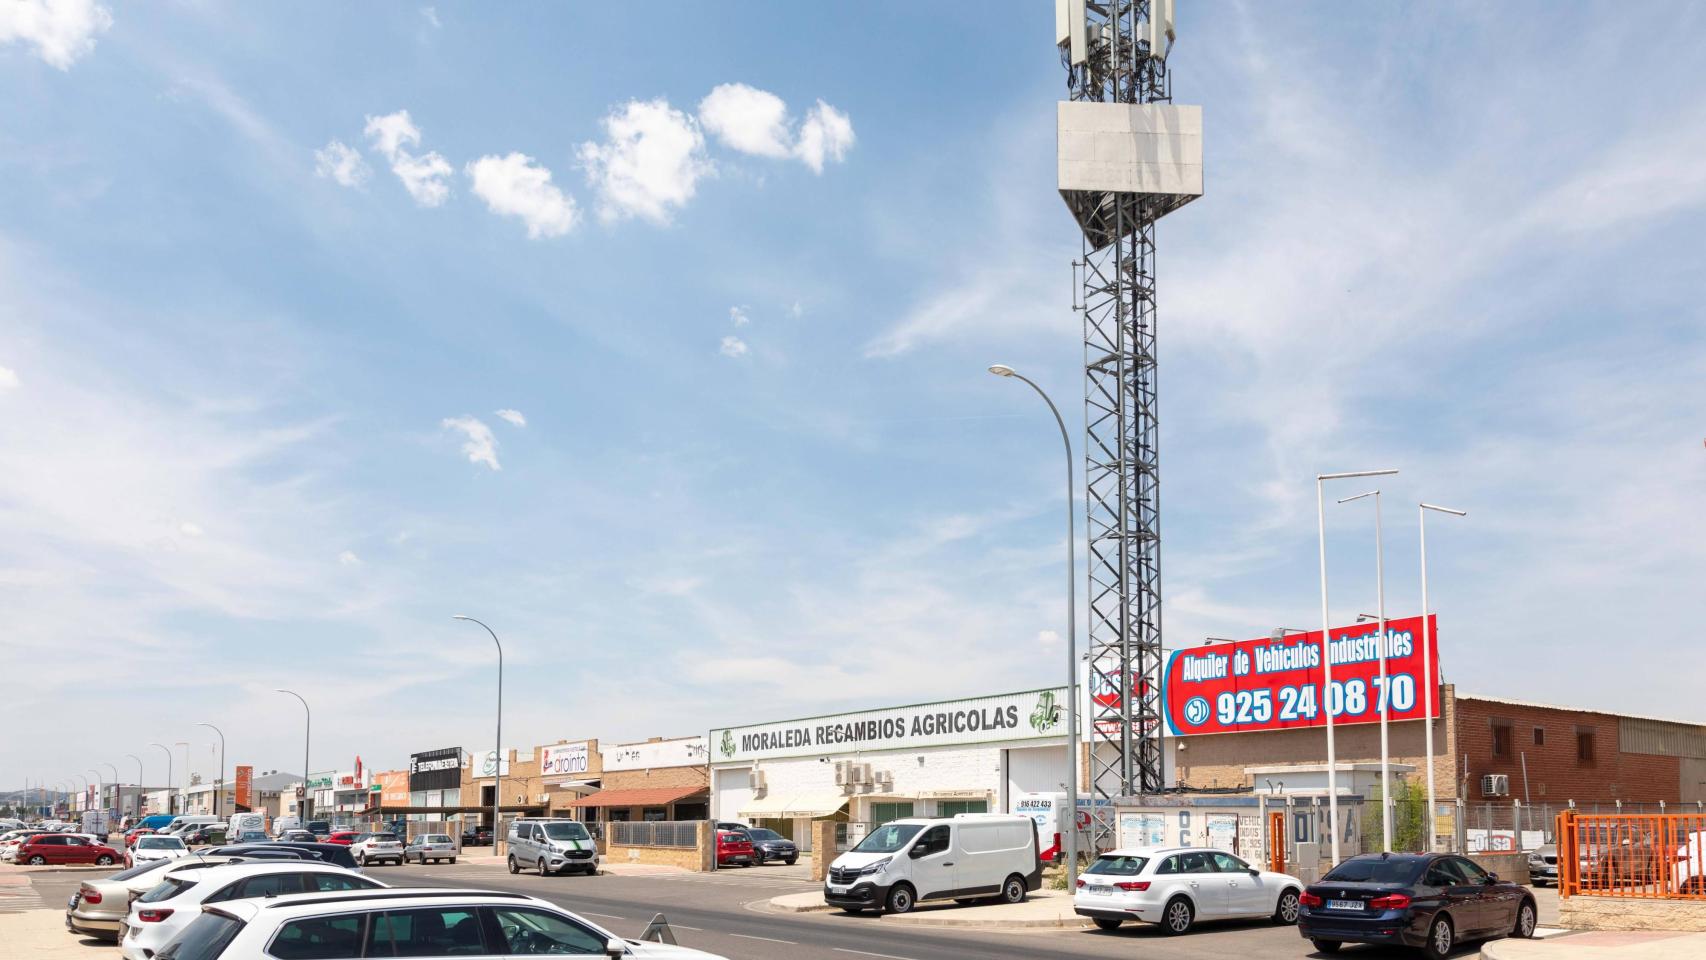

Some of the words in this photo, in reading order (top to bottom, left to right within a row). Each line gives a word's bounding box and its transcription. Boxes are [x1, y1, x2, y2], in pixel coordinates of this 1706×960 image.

[1183, 653, 1228, 682] Alquiler
[1234, 650, 1249, 676] de
[1254, 643, 1319, 673] Vehiculos
[1329, 630, 1412, 665] ndustriles
[1218, 690, 1272, 724] 925
[1279, 686, 1317, 719] 24
[1324, 679, 1366, 716] 08
[1373, 674, 1414, 713] 70
[742, 727, 811, 752] MORALEDA
[816, 716, 905, 745] RECAMBIOS
[911, 705, 1018, 736] AGRICOLAS
